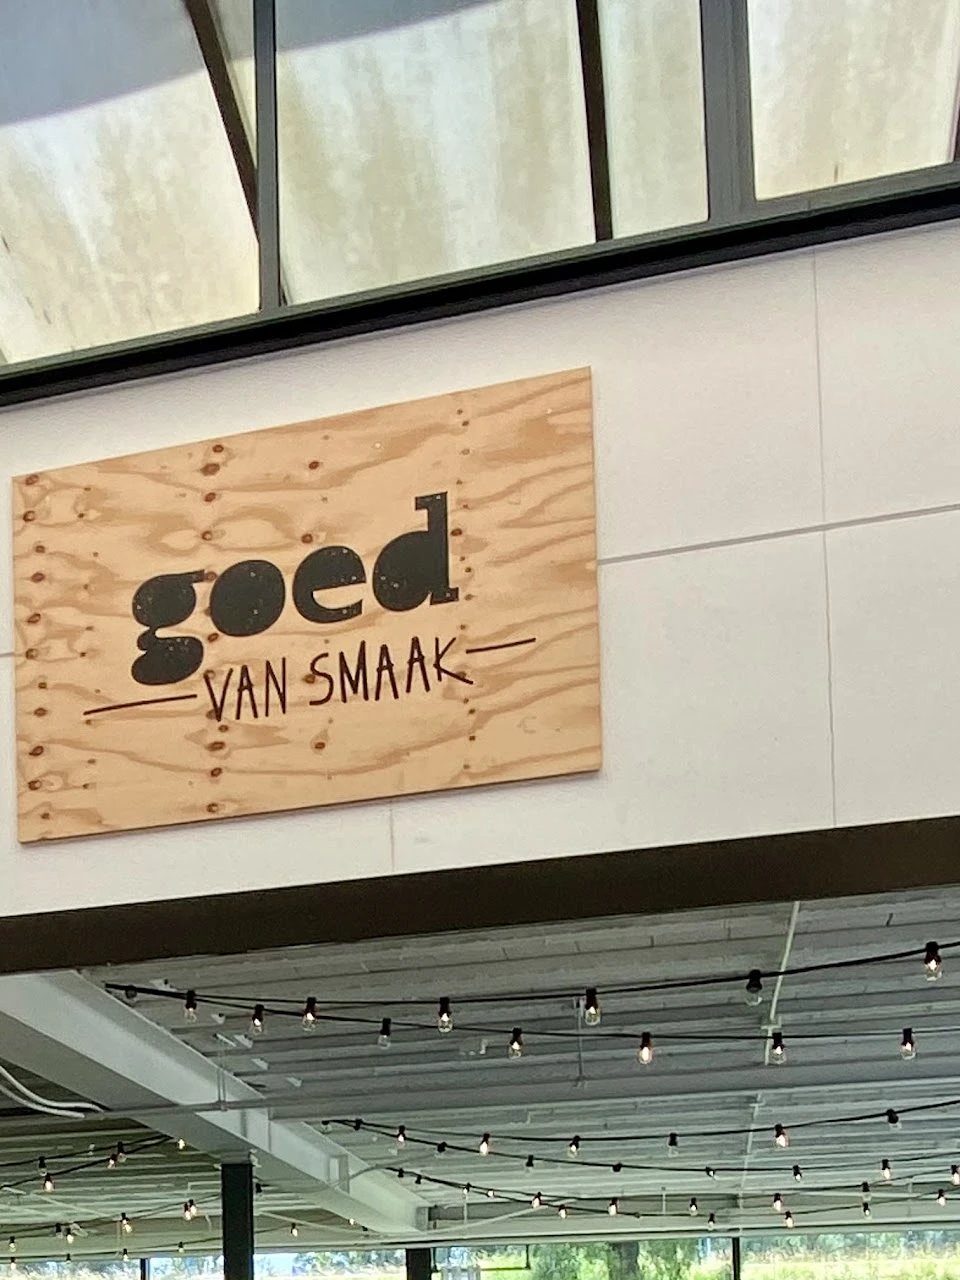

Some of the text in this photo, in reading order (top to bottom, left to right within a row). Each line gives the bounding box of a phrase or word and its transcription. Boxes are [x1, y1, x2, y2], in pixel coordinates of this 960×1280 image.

[131, 491, 459, 686] goed
[203, 637, 473, 722] VAN SMAAK
